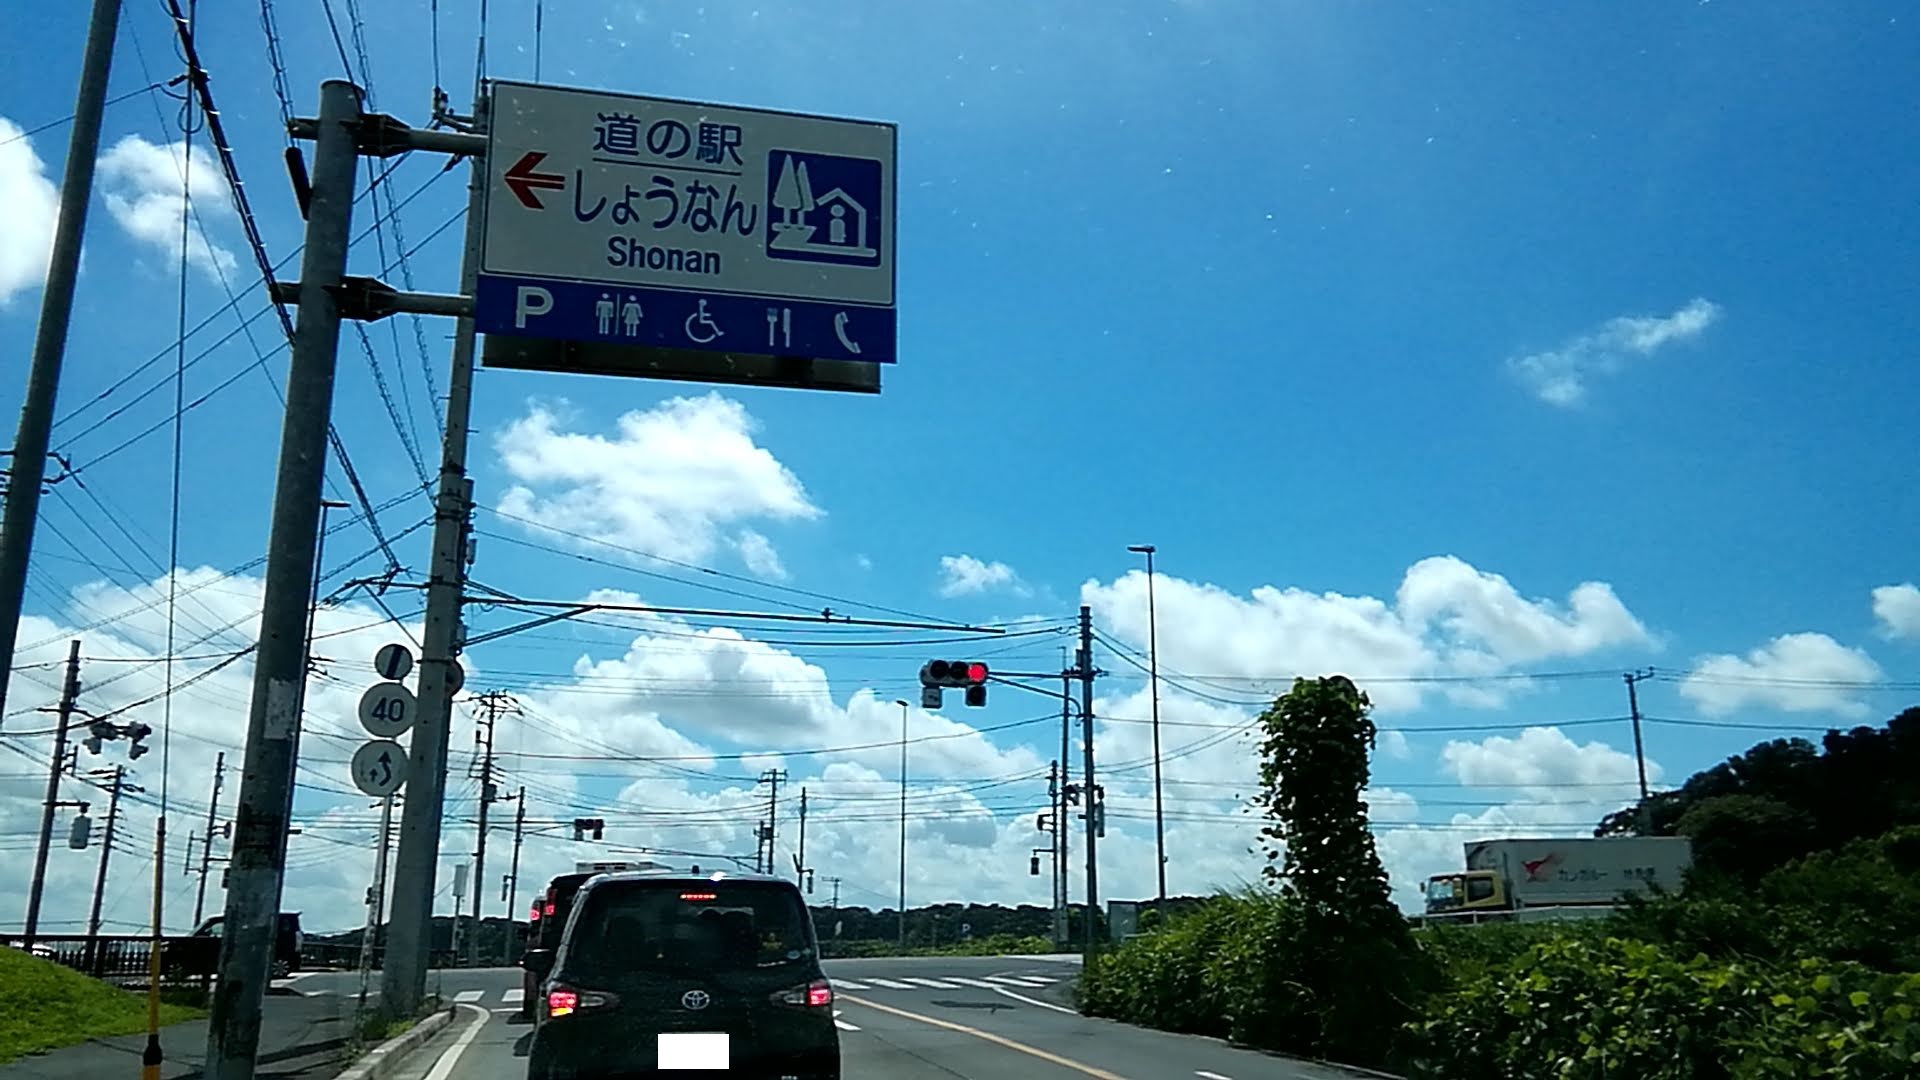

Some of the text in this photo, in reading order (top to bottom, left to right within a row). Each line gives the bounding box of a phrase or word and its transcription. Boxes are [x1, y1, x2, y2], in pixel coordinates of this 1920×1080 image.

[593, 112, 744, 166] 道の駅
[574, 169, 757, 237] しょうなん
[607, 236, 720, 275] Shonan
[515, 286, 554, 329] P
[371, 697, 405, 722] 40
